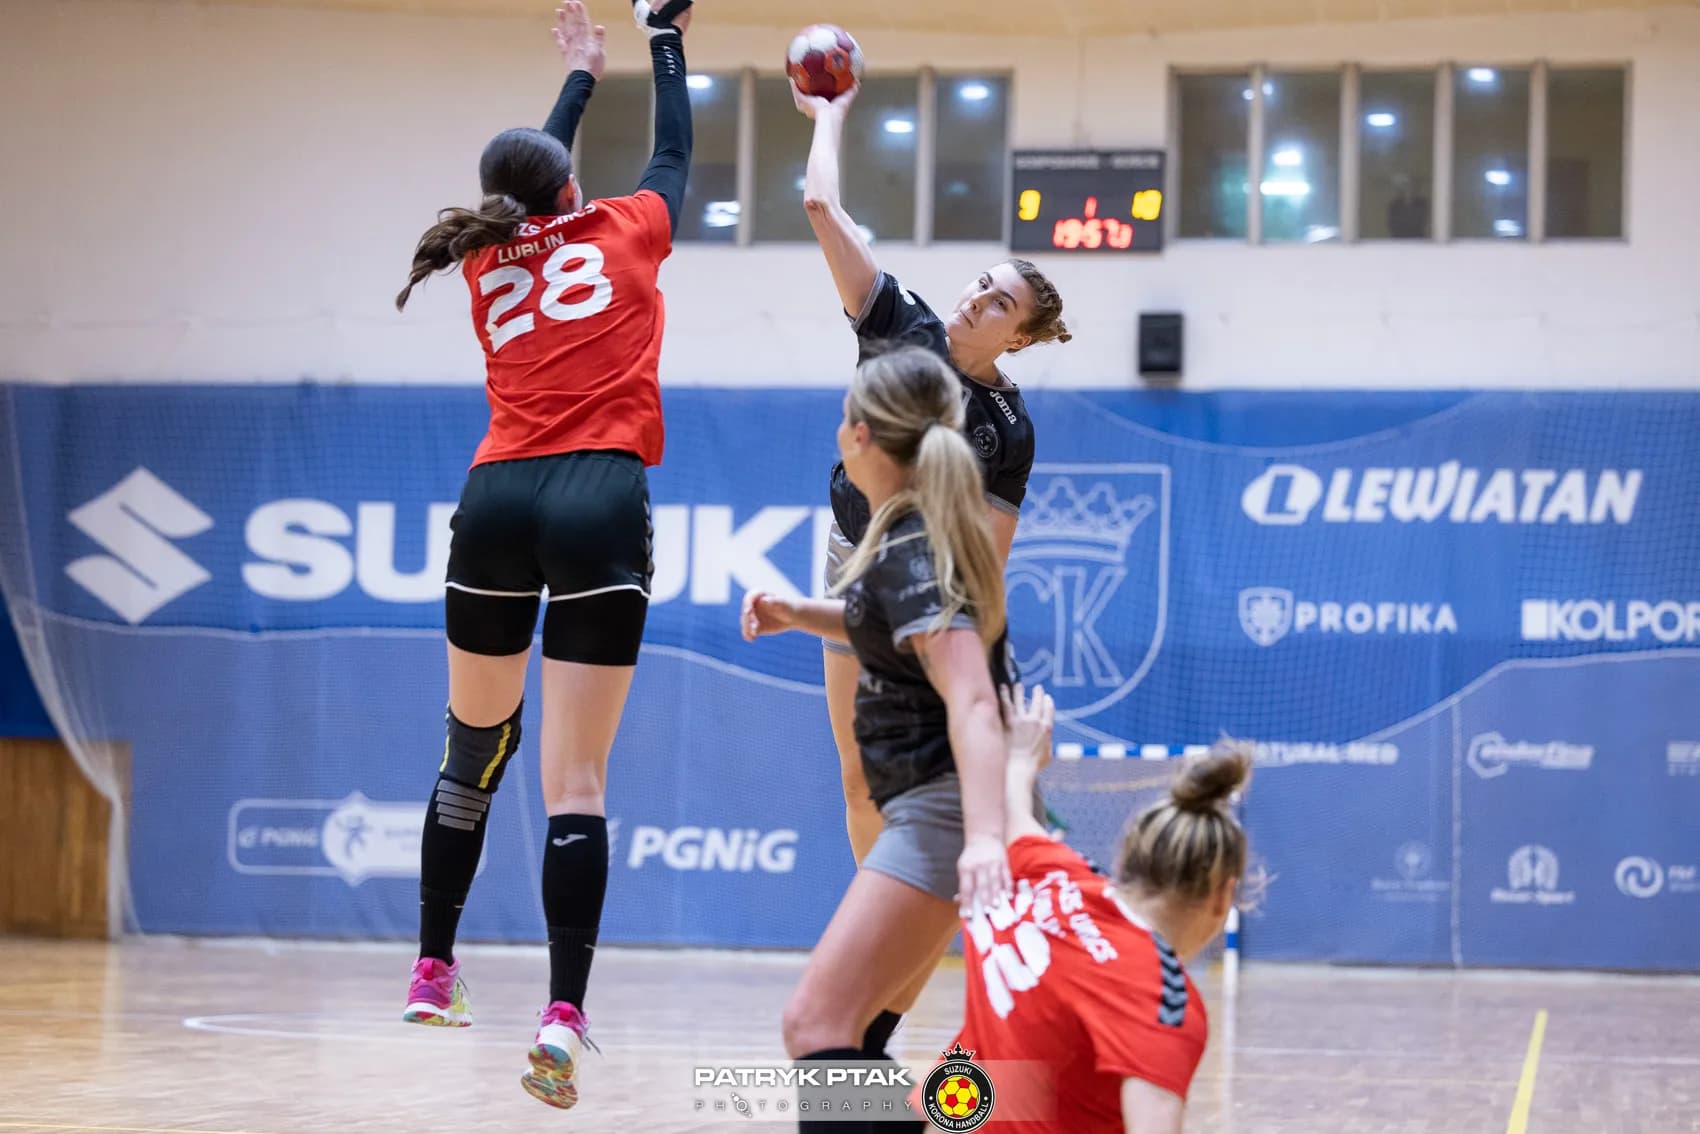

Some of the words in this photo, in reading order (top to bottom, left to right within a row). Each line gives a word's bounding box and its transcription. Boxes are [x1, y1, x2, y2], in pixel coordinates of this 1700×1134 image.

[498, 232, 565, 264] LUBLIN
[478, 243, 613, 353] 28
[1322, 460, 1643, 524] LEWIATAN
[1295, 602, 1458, 635] PROFIKA
[627, 826, 799, 873] PGNiG
